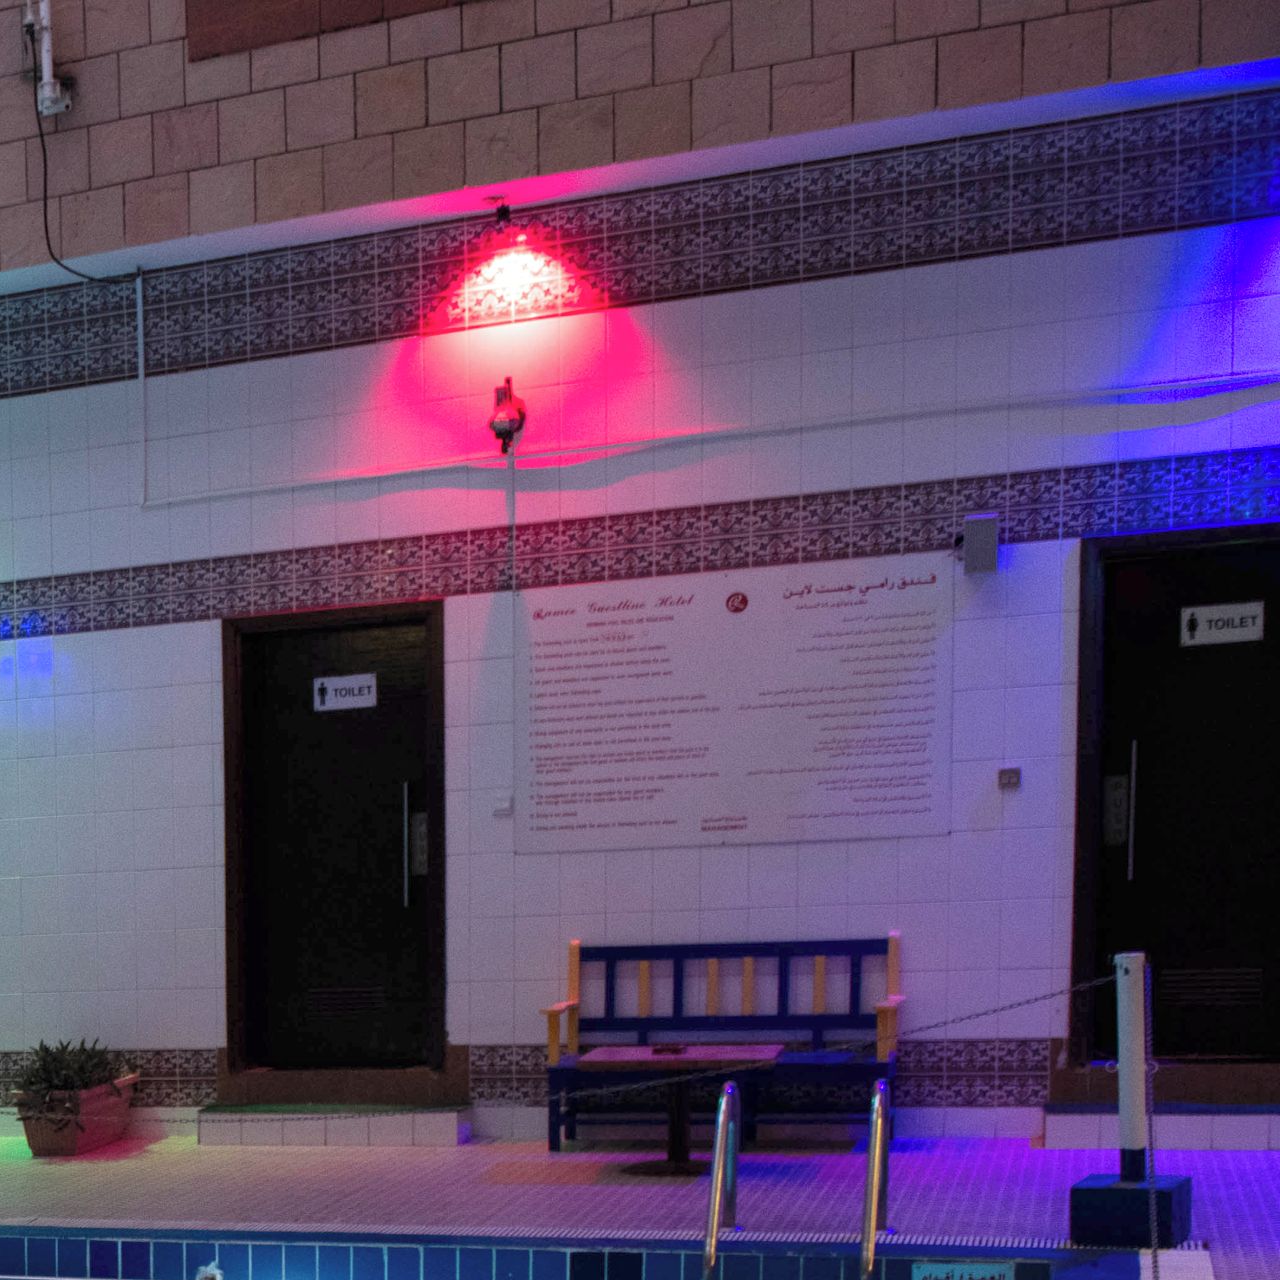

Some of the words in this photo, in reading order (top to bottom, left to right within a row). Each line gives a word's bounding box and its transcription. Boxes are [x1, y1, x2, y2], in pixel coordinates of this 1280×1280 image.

[815, 584, 856, 595] جست
[859, 577, 895, 597] رامي
[897, 573, 937, 591] فندق
[783, 584, 813, 600] لاين
[533, 608, 577, 621] Ramee
[587, 598, 646, 615] Guestline
[655, 594, 696, 608] Hotel
[1205, 615, 1259, 631] TOILET
[333, 685, 373, 698] TOILET
